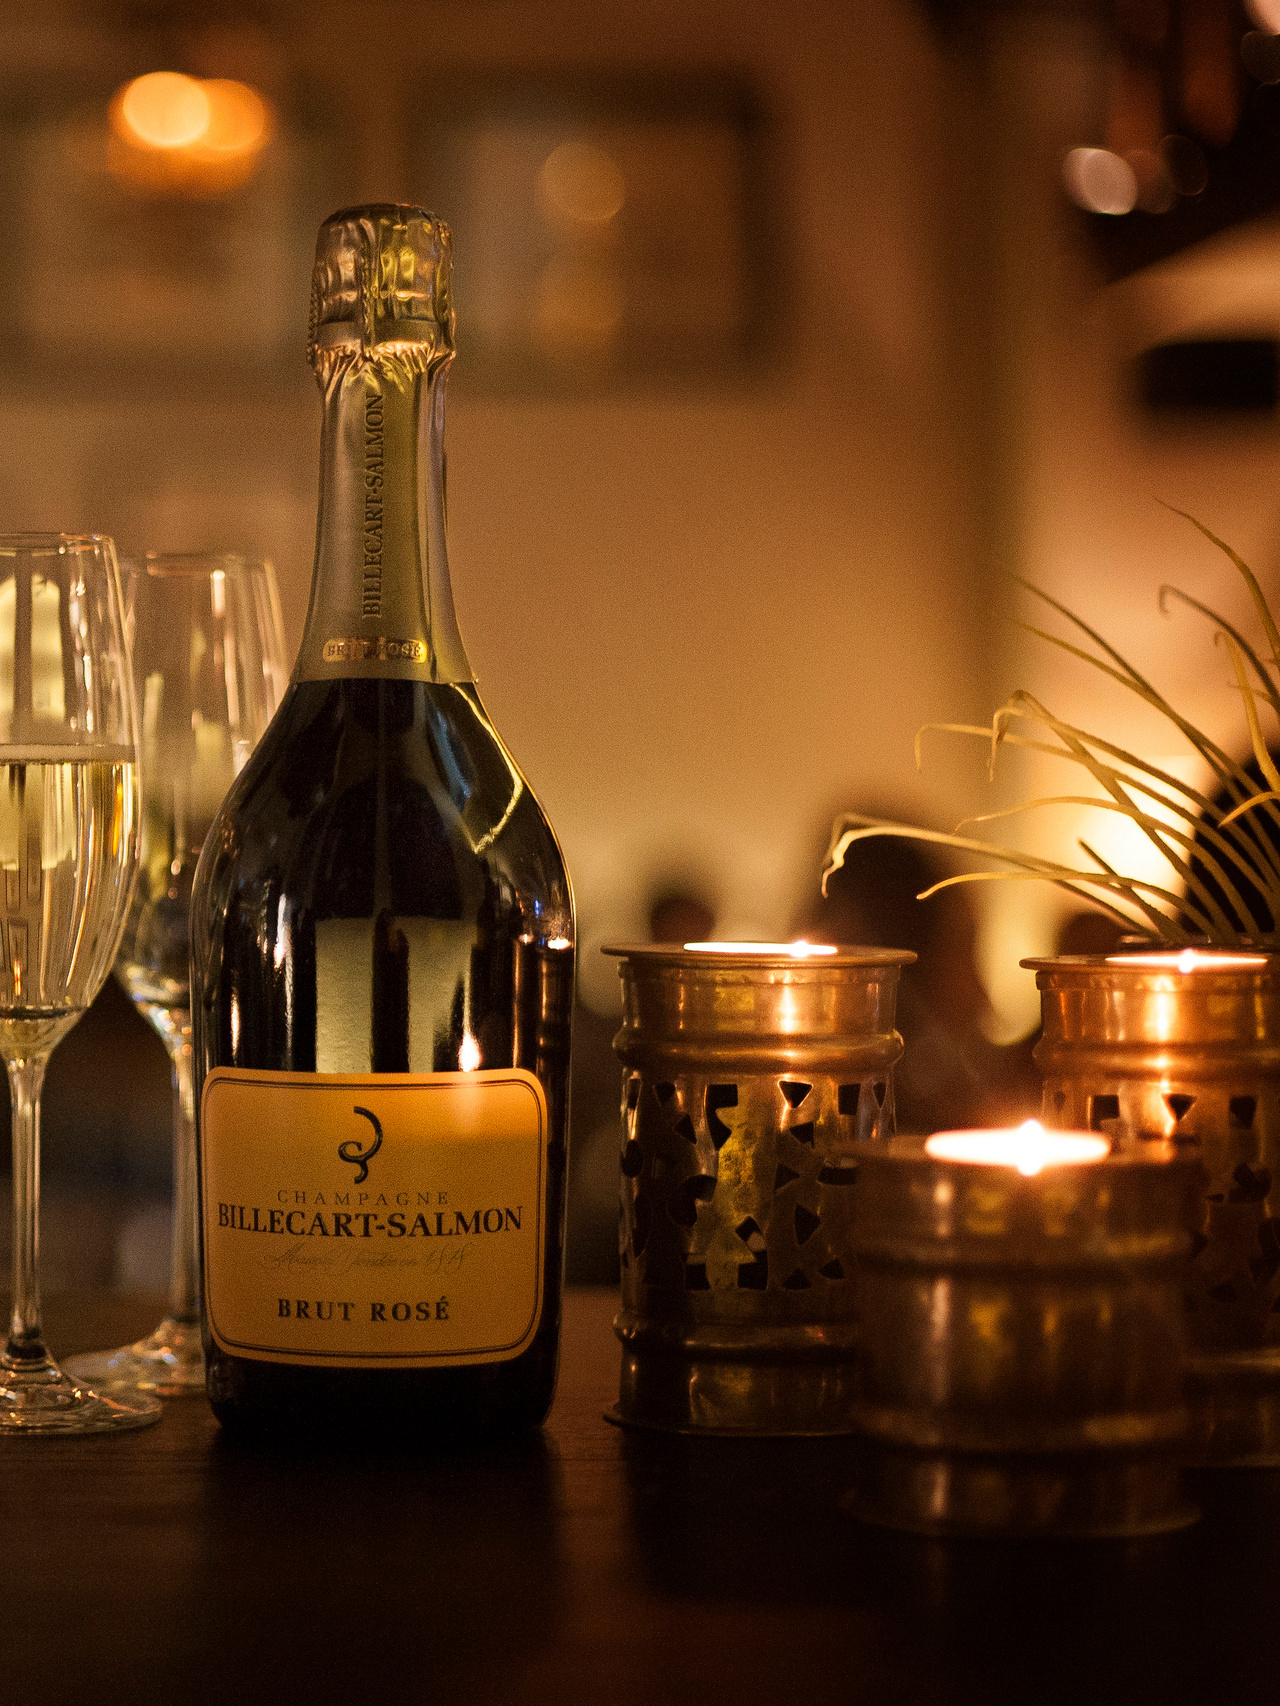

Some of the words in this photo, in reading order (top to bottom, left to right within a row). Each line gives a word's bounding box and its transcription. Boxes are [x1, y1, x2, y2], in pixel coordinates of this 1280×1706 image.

[362, 392, 384, 618] BILLECART-SALMON
[277, 1190, 449, 1206] CHAMPAGNE
[218, 1202, 523, 1238] BILLECART-SALMON
[278, 1299, 355, 1322] BRUT
[370, 1296, 450, 1322] ROSÉ
